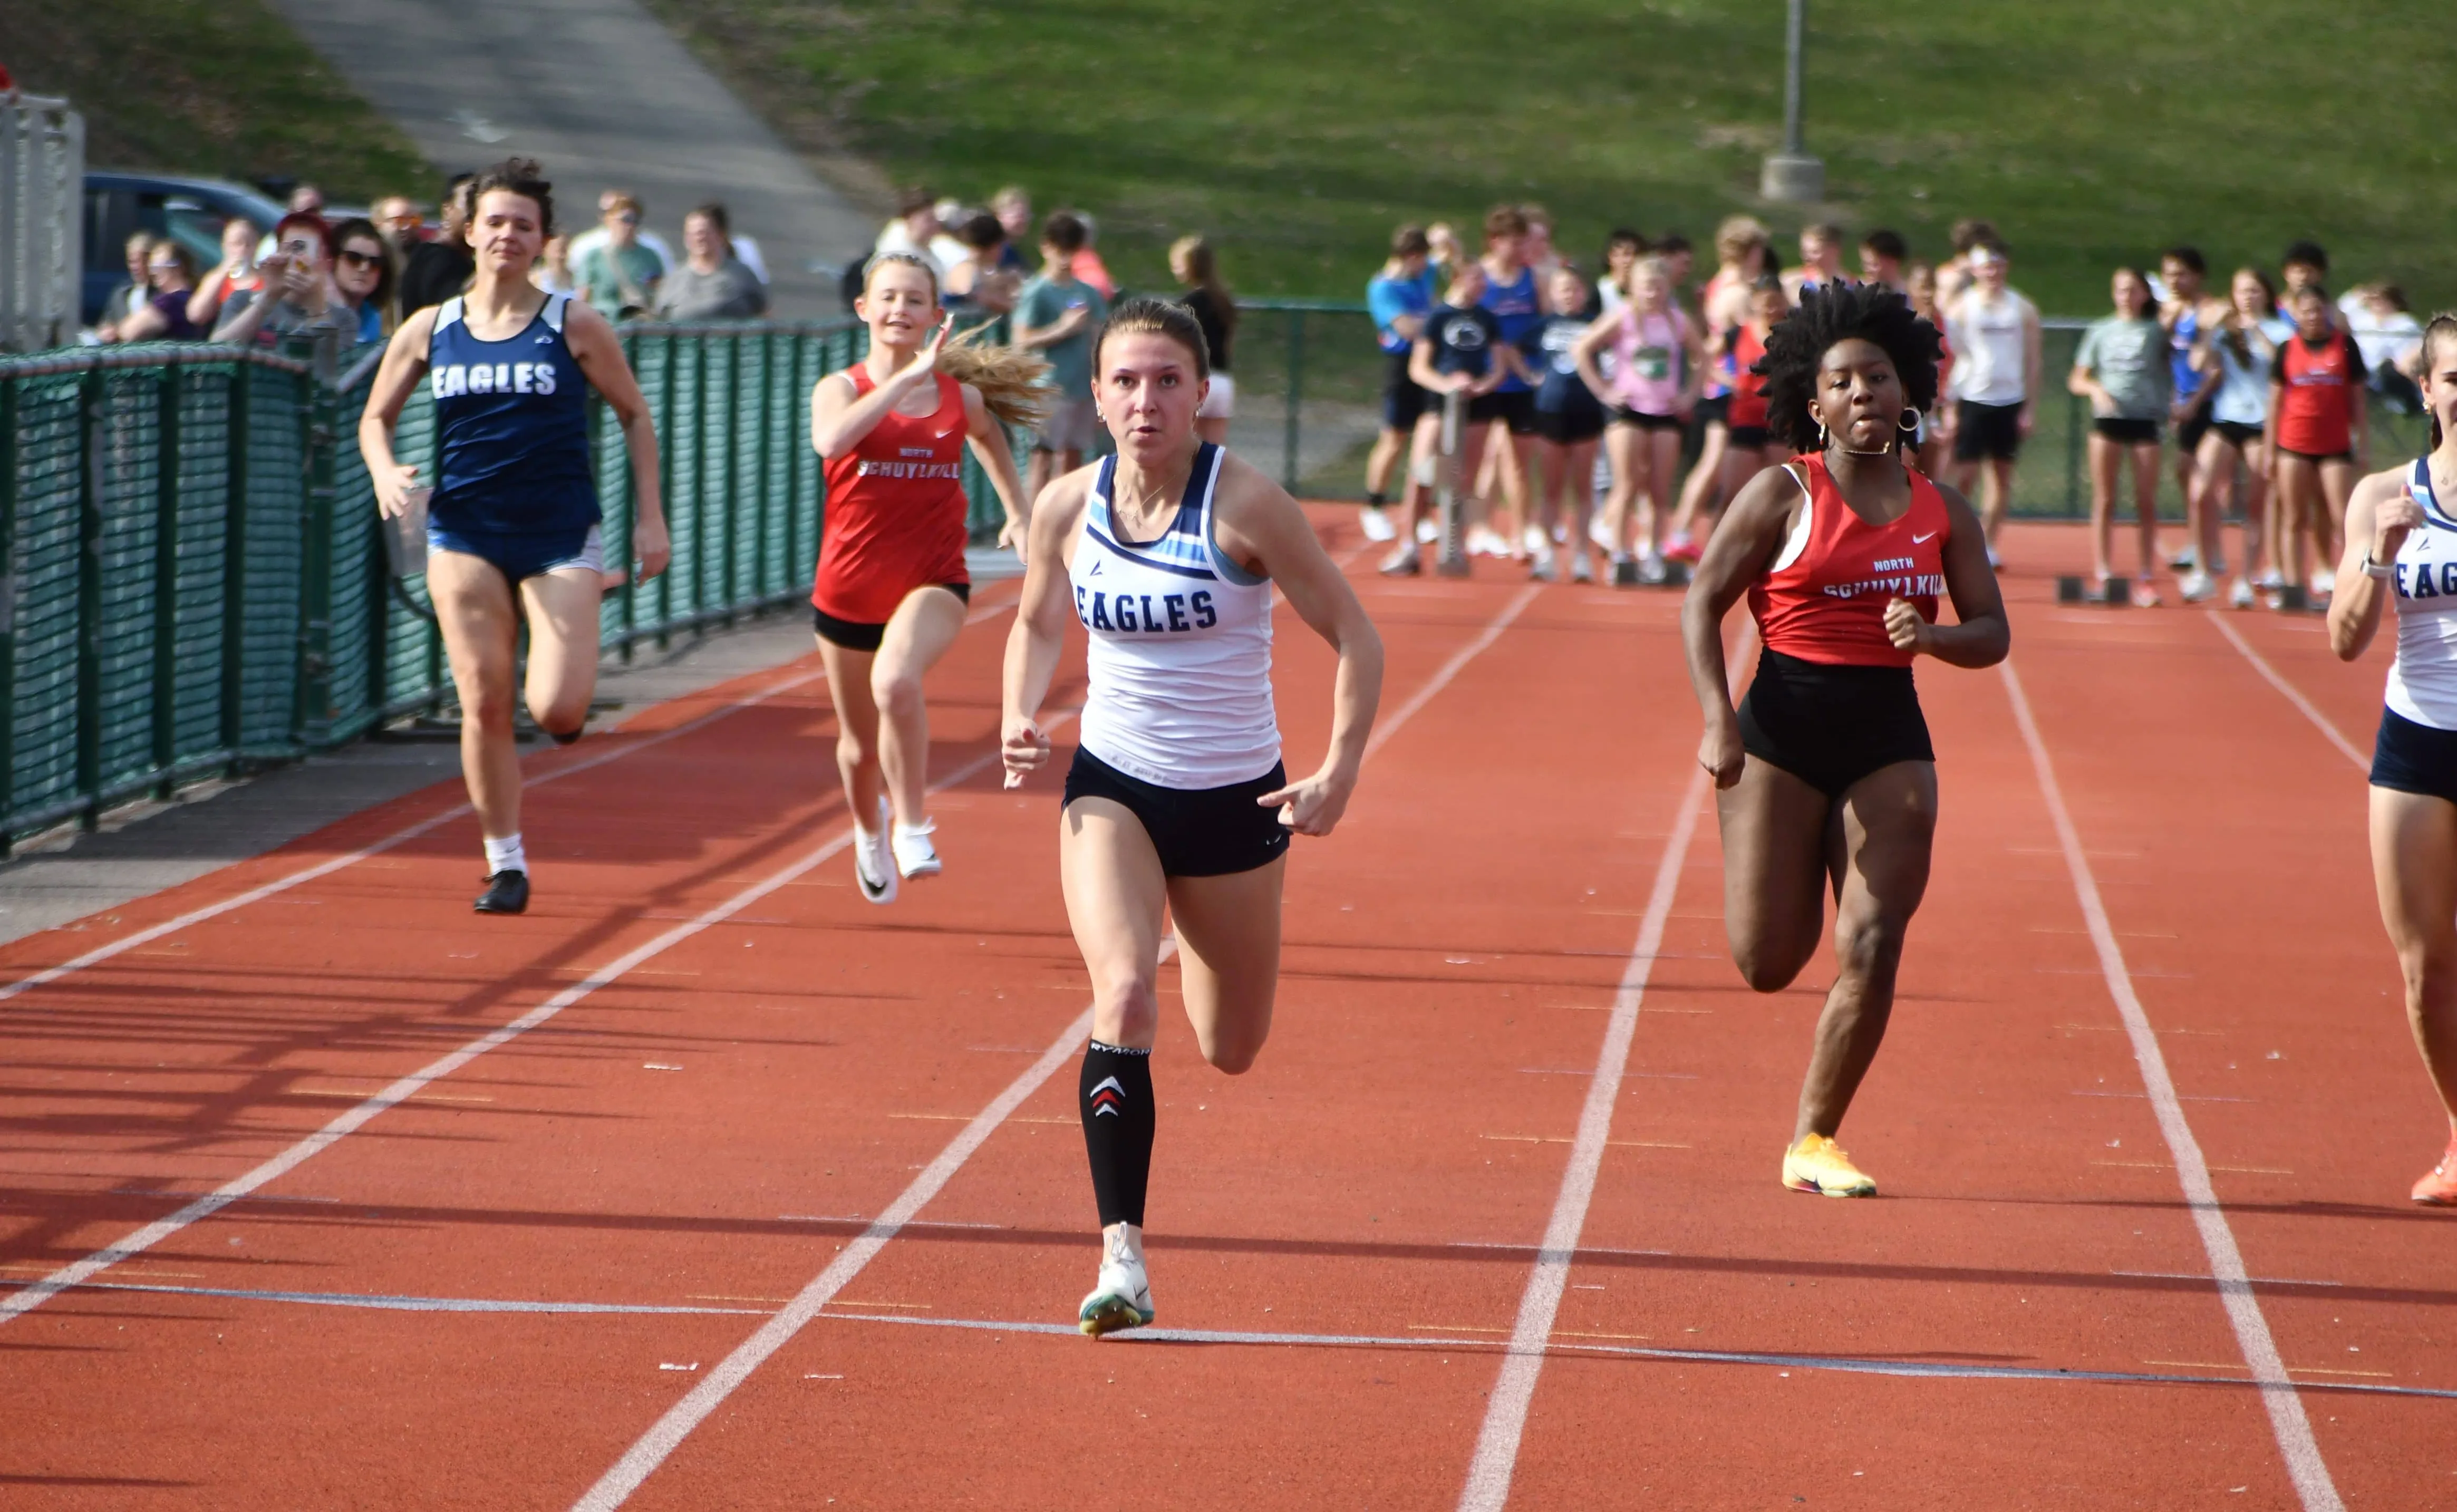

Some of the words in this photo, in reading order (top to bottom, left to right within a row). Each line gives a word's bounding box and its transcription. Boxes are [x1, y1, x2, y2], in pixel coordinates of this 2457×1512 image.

[431, 362, 556, 399] EAGLES
[1873, 557, 1914, 572] NORTH
[1077, 585, 1217, 632] EAGLES
